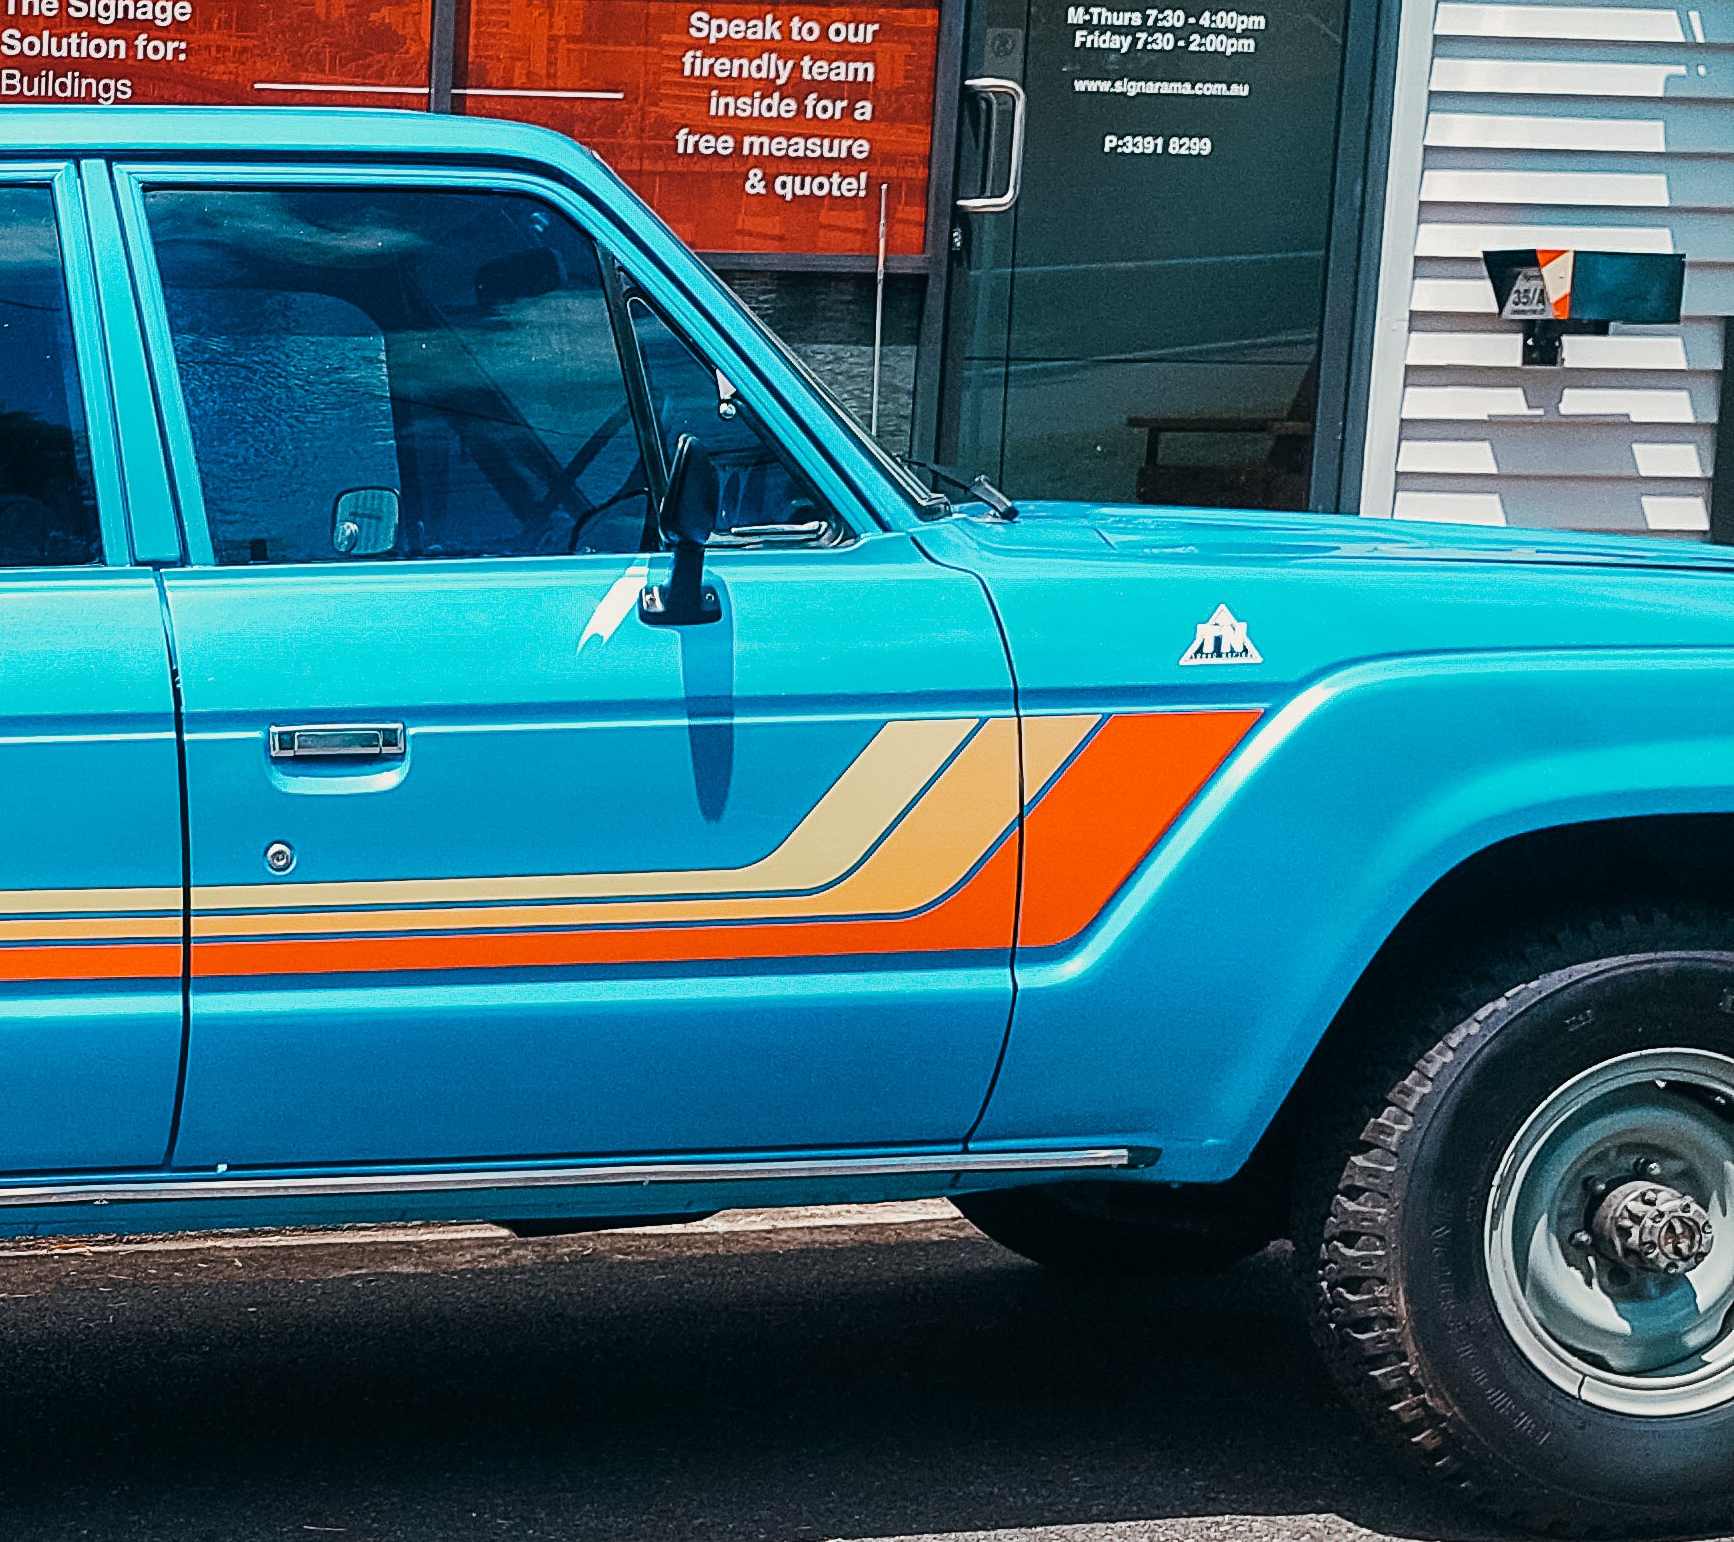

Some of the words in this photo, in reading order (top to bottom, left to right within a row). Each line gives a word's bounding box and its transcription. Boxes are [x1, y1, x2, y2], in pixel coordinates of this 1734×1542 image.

[688, 11, 782, 44] Speak
[790, 17, 819, 42] to
[827, 20, 879, 44] our
[1067, 6, 1142, 26] M-Thurs
[1146, 9, 1183, 28] 7:30
[1198, 11, 1266, 33] 4:00pm
[0, 29, 126, 59] Solution
[134, 32, 187, 61] for:
[1074, 30, 1132, 53] Friday
[1135, 32, 1174, 51] 7:30
[1188, 33, 1255, 56] 2:00pm
[682, 50, 794, 85] firendly
[800, 57, 875, 83] team
[0, 67, 133, 105] Buildings
[1074, 77, 1249, 96] www.signarama.com.au
[709, 89, 796, 119] inside
[804, 92, 847, 120] for
[854, 100, 873, 121] a
[675, 128, 734, 156] free
[742, 134, 869, 159] measure
[1104, 135, 1163, 154] P:3391
[1168, 137, 1211, 155] 8299
[744, 169, 766, 194] &
[774, 171, 867, 201] quote!
